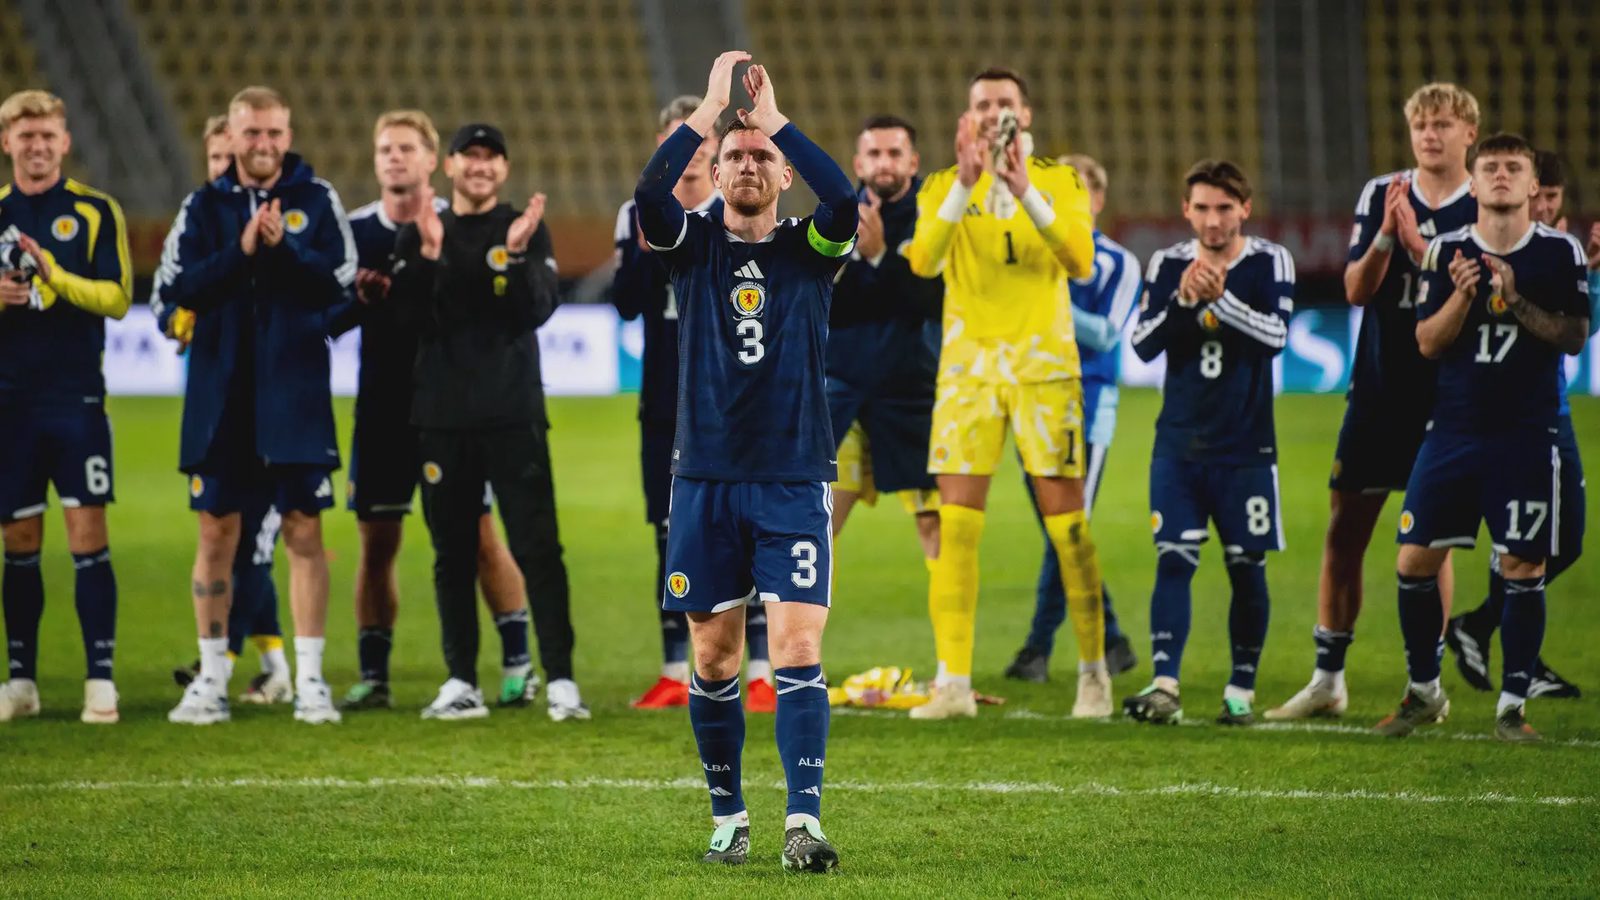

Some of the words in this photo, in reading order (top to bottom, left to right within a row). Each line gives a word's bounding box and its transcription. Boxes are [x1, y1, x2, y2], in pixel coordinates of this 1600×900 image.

[1004, 231, 1018, 265] 1
[736, 318, 765, 365] 3
[1200, 340, 1223, 379] 8
[1474, 323, 1518, 363] 17
[1064, 429, 1076, 465] 1
[84, 454, 111, 495] 6
[1245, 495, 1271, 536] 8
[1505, 499, 1548, 541] 17
[790, 541, 817, 588] 3
